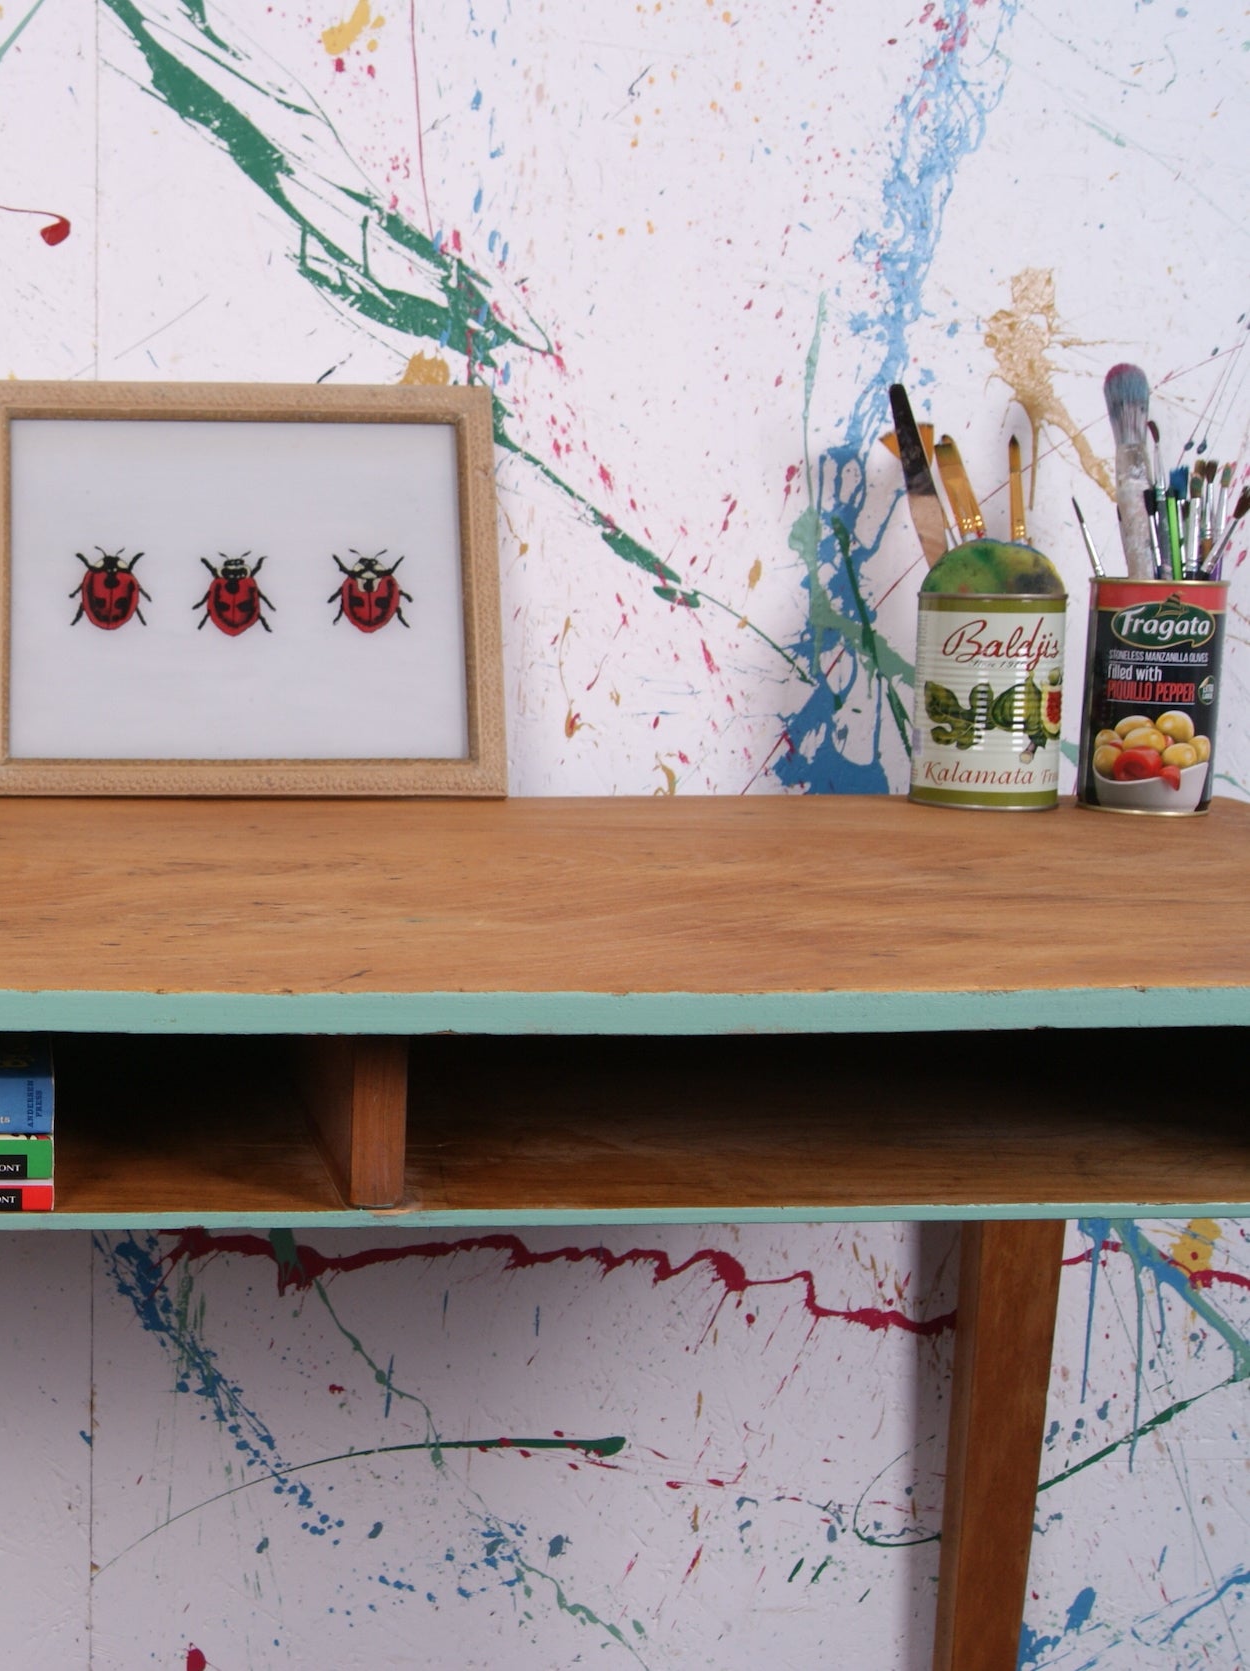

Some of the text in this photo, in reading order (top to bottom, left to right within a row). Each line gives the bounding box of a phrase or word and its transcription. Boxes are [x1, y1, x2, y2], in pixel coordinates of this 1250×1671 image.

[1119, 606, 1211, 641] Fragata
[942, 617, 1060, 671] Baldjis
[1108, 649, 1209, 663] STONELESS MANZANILLA OLIVES
[1108, 664, 1162, 682] filled with
[1107, 679, 1195, 702] PIQUILLO PEPPER
[923, 760, 1034, 785] Kalamata
[35, 1090, 43, 1117] PRESS
